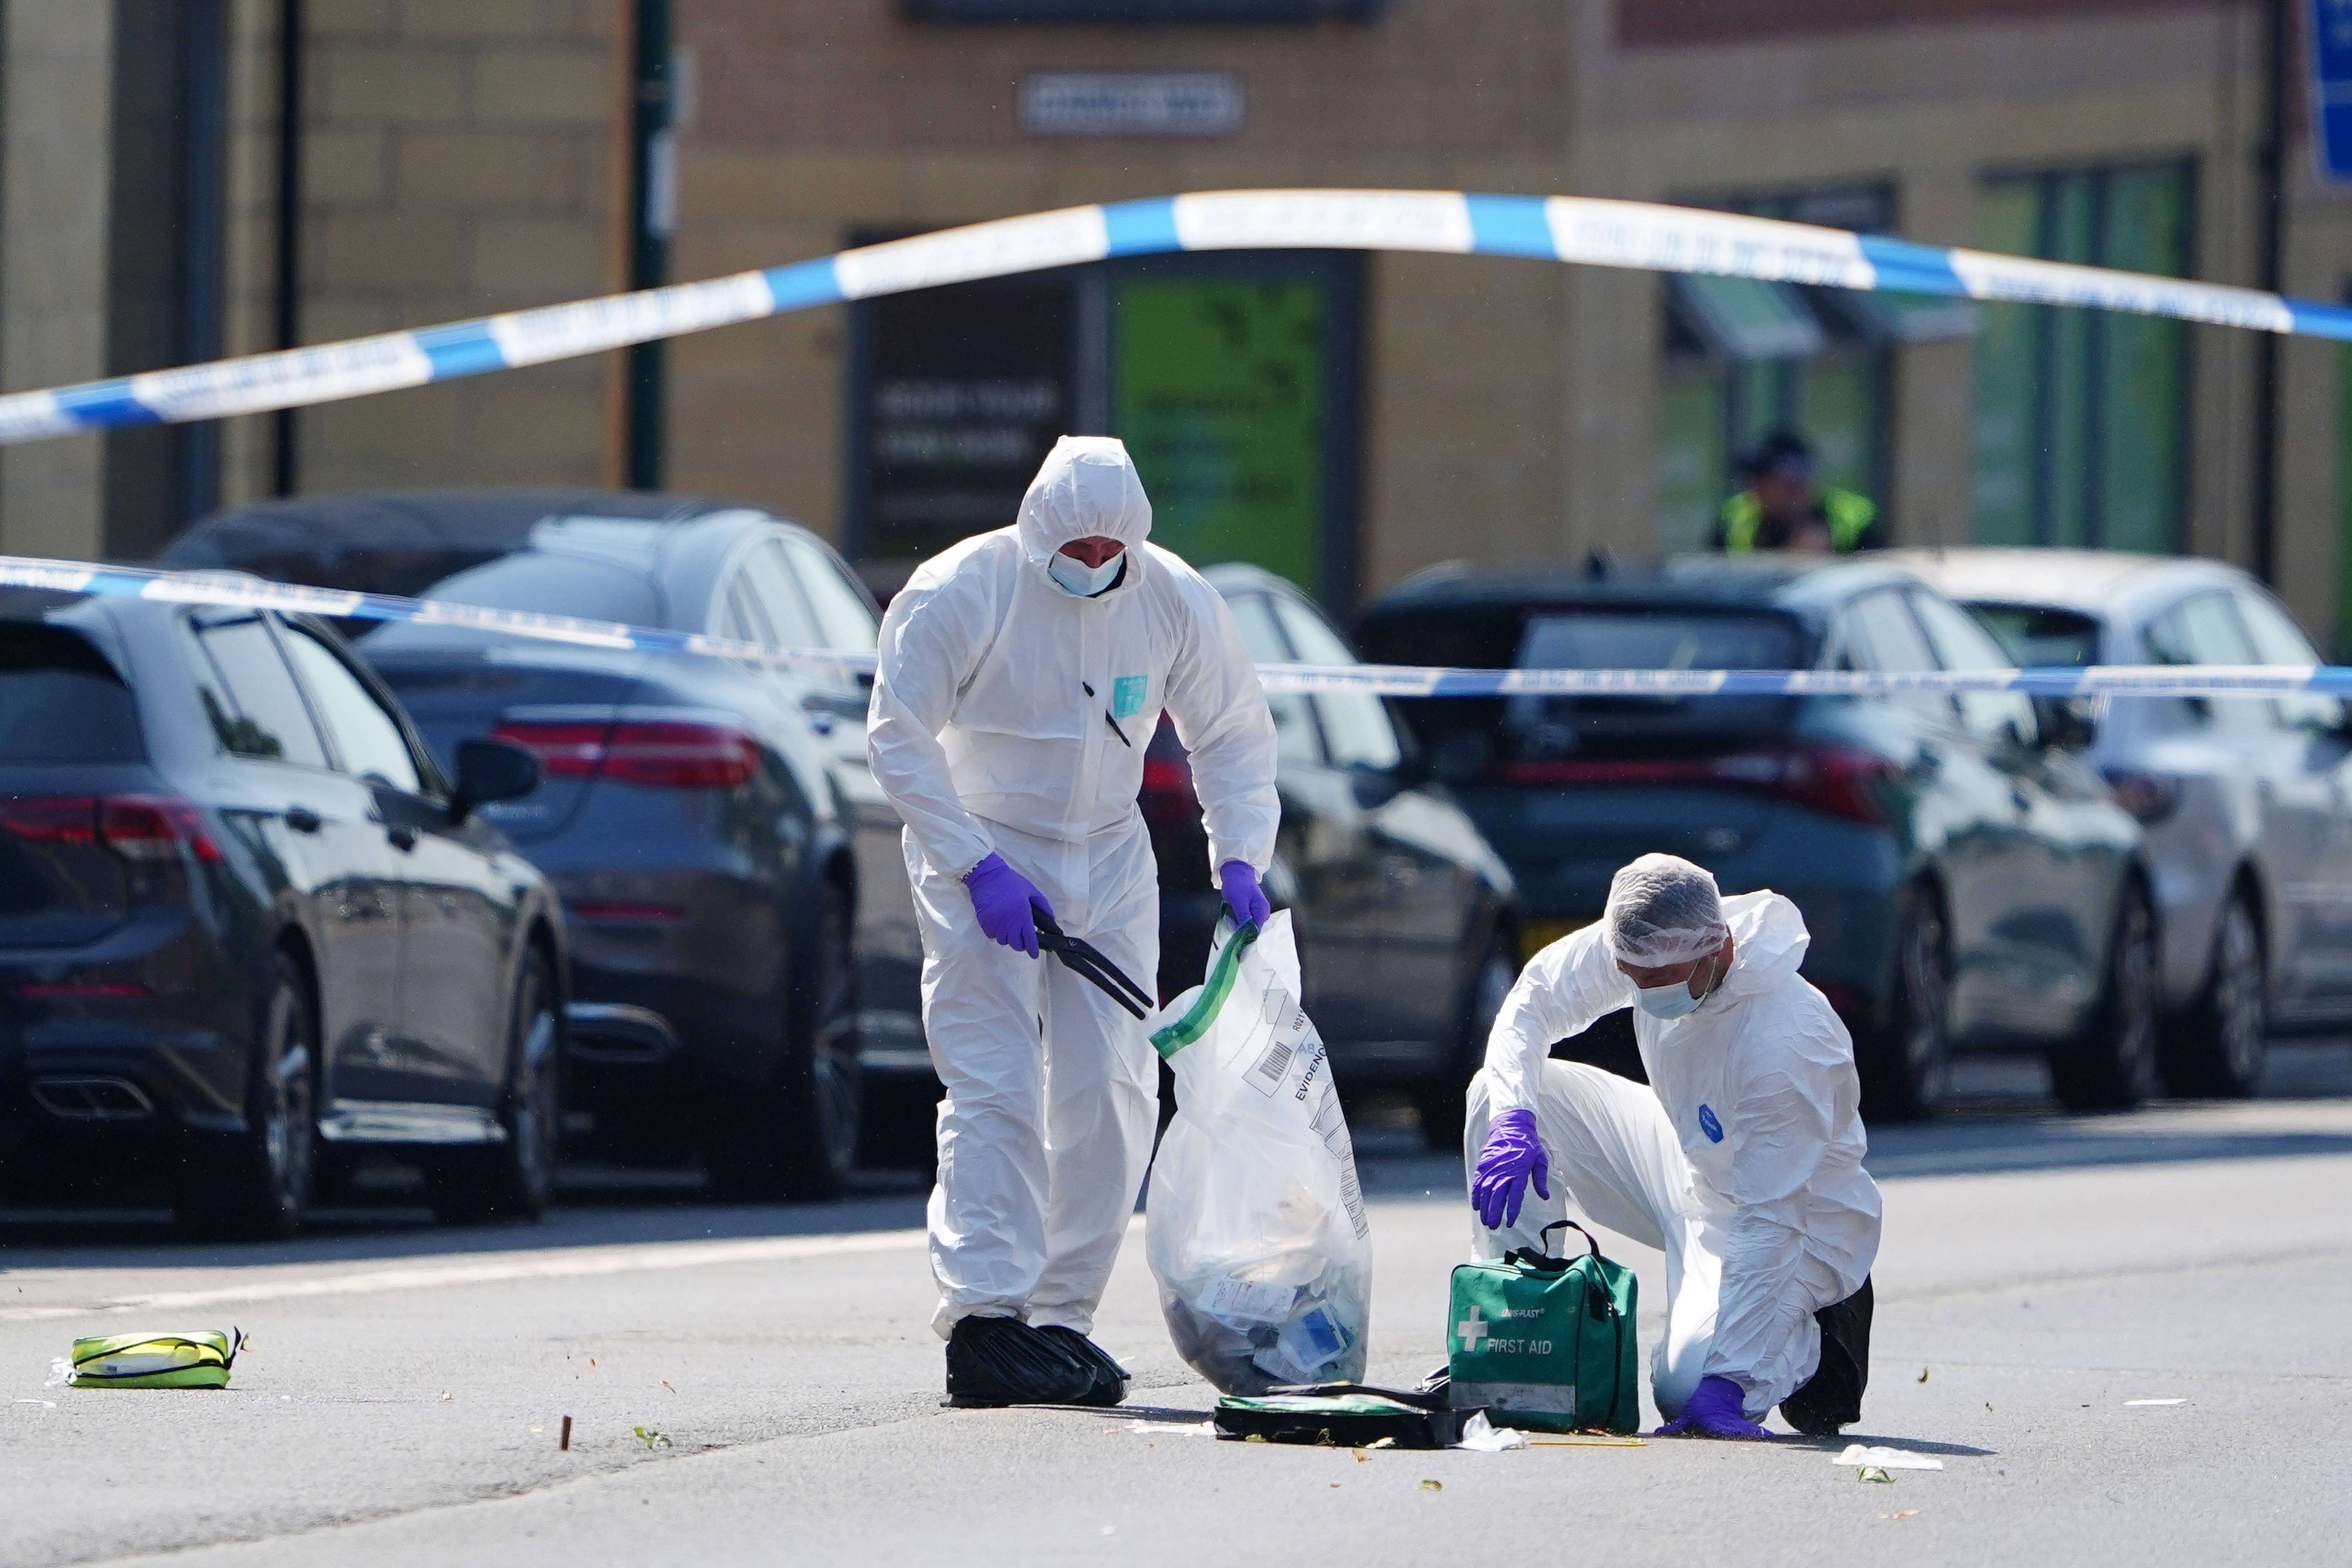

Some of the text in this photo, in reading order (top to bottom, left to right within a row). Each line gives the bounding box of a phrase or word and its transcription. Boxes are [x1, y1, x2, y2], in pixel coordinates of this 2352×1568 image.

[1292, 1009, 1305, 1032] R021
[1295, 1047, 1327, 1101] EVIDENC
[1487, 1338, 1552, 1354] FIRST AID
